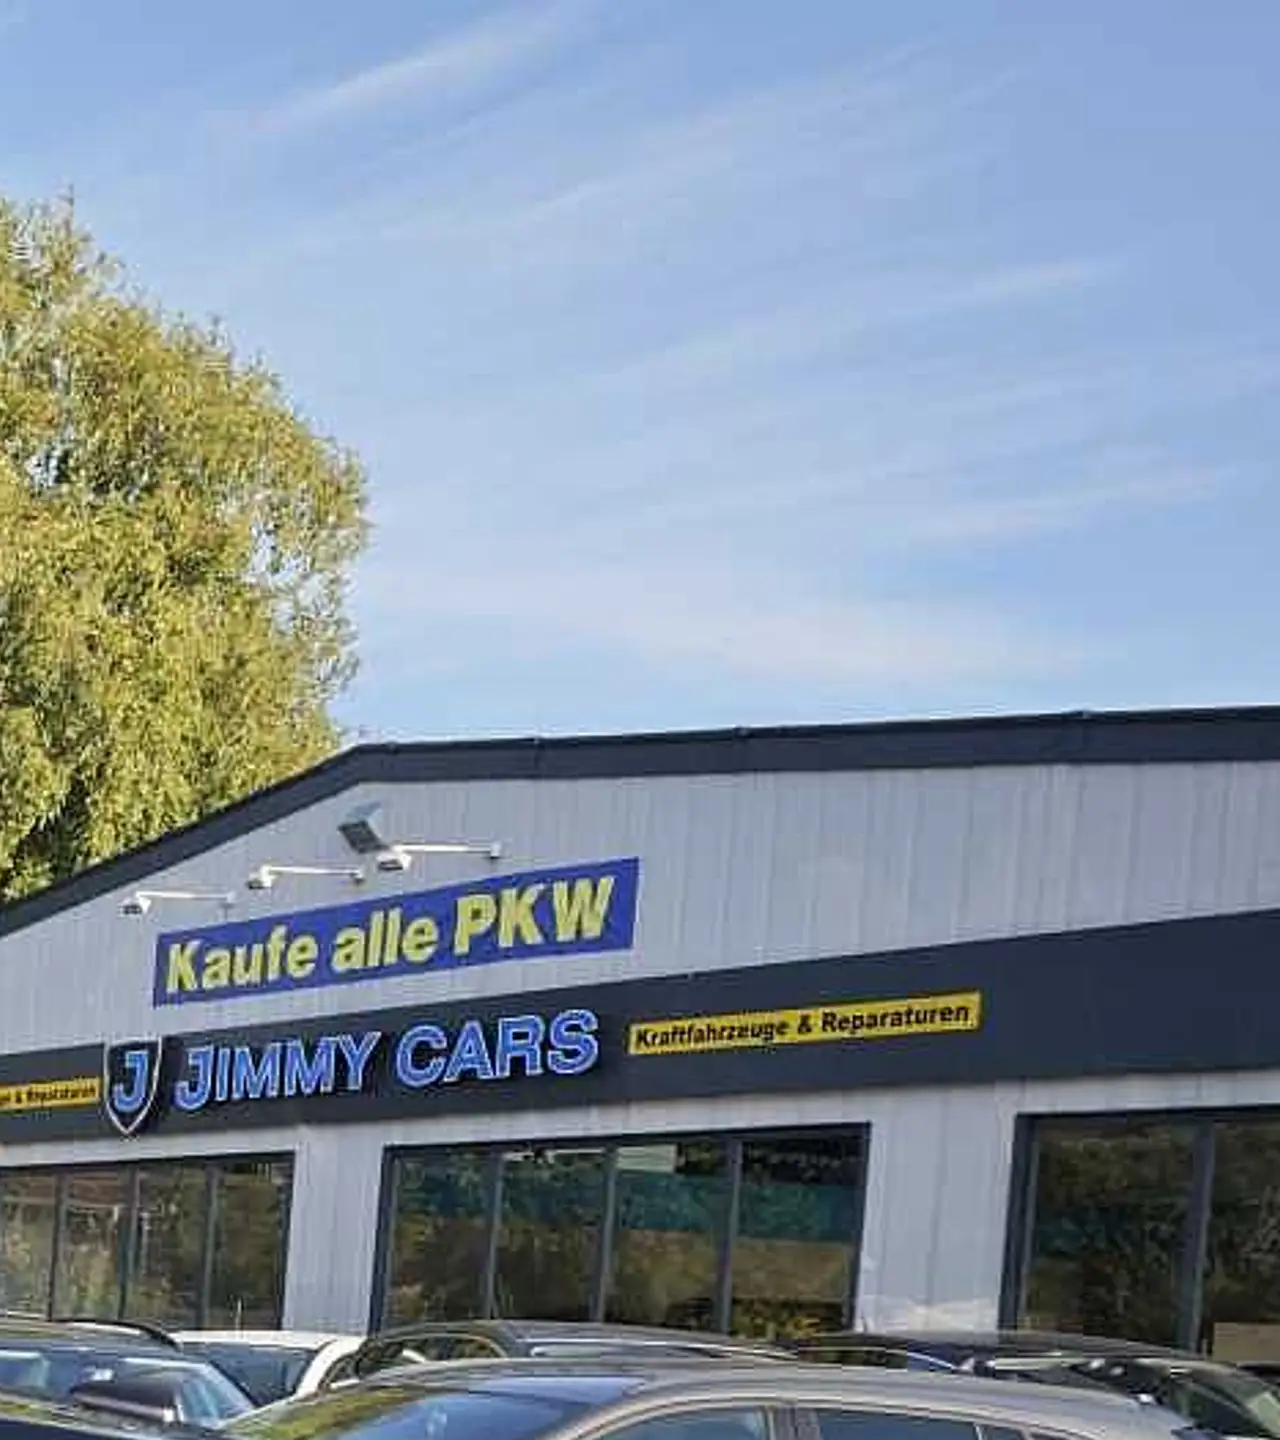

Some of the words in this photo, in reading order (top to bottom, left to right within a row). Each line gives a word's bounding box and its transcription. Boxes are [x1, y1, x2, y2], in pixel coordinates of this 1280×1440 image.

[167, 925, 319, 994] Kaufe
[331, 908, 438, 974] alle
[453, 876, 616, 954] PKW
[174, 1031, 382, 1112] JIMMY
[395, 1010, 599, 1088] CARS
[638, 1018, 790, 1049] Kraftfahrzeuge
[797, 1013, 813, 1036] &
[821, 1003, 971, 1037] Reparaturen
[111, 1050, 150, 1114] J
